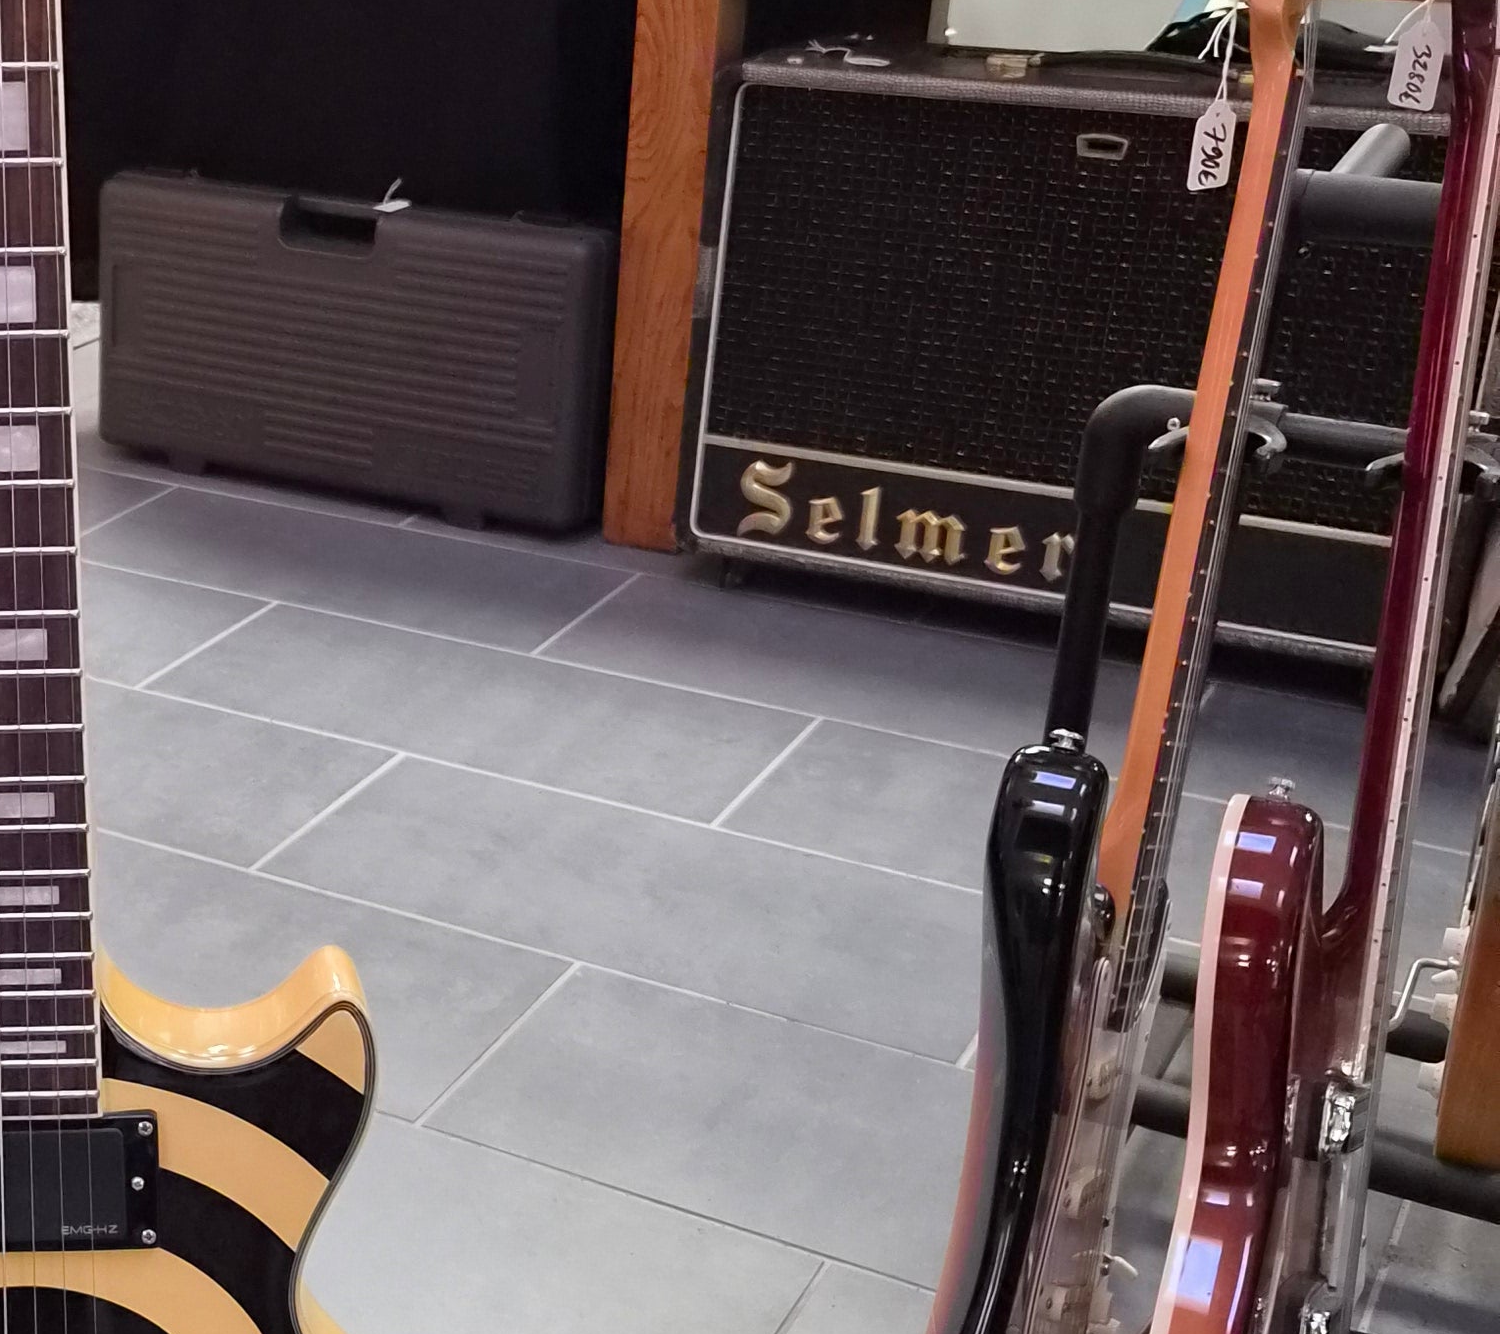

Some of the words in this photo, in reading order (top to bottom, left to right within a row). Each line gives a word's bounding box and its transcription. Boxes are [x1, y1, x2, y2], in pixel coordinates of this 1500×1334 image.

[1398, 44, 1432, 104] 3280€
[1198, 123, 1227, 187] 790€
[737, 460, 1075, 582] Selmer
[61, 1224, 119, 1236] EMG-HZ
